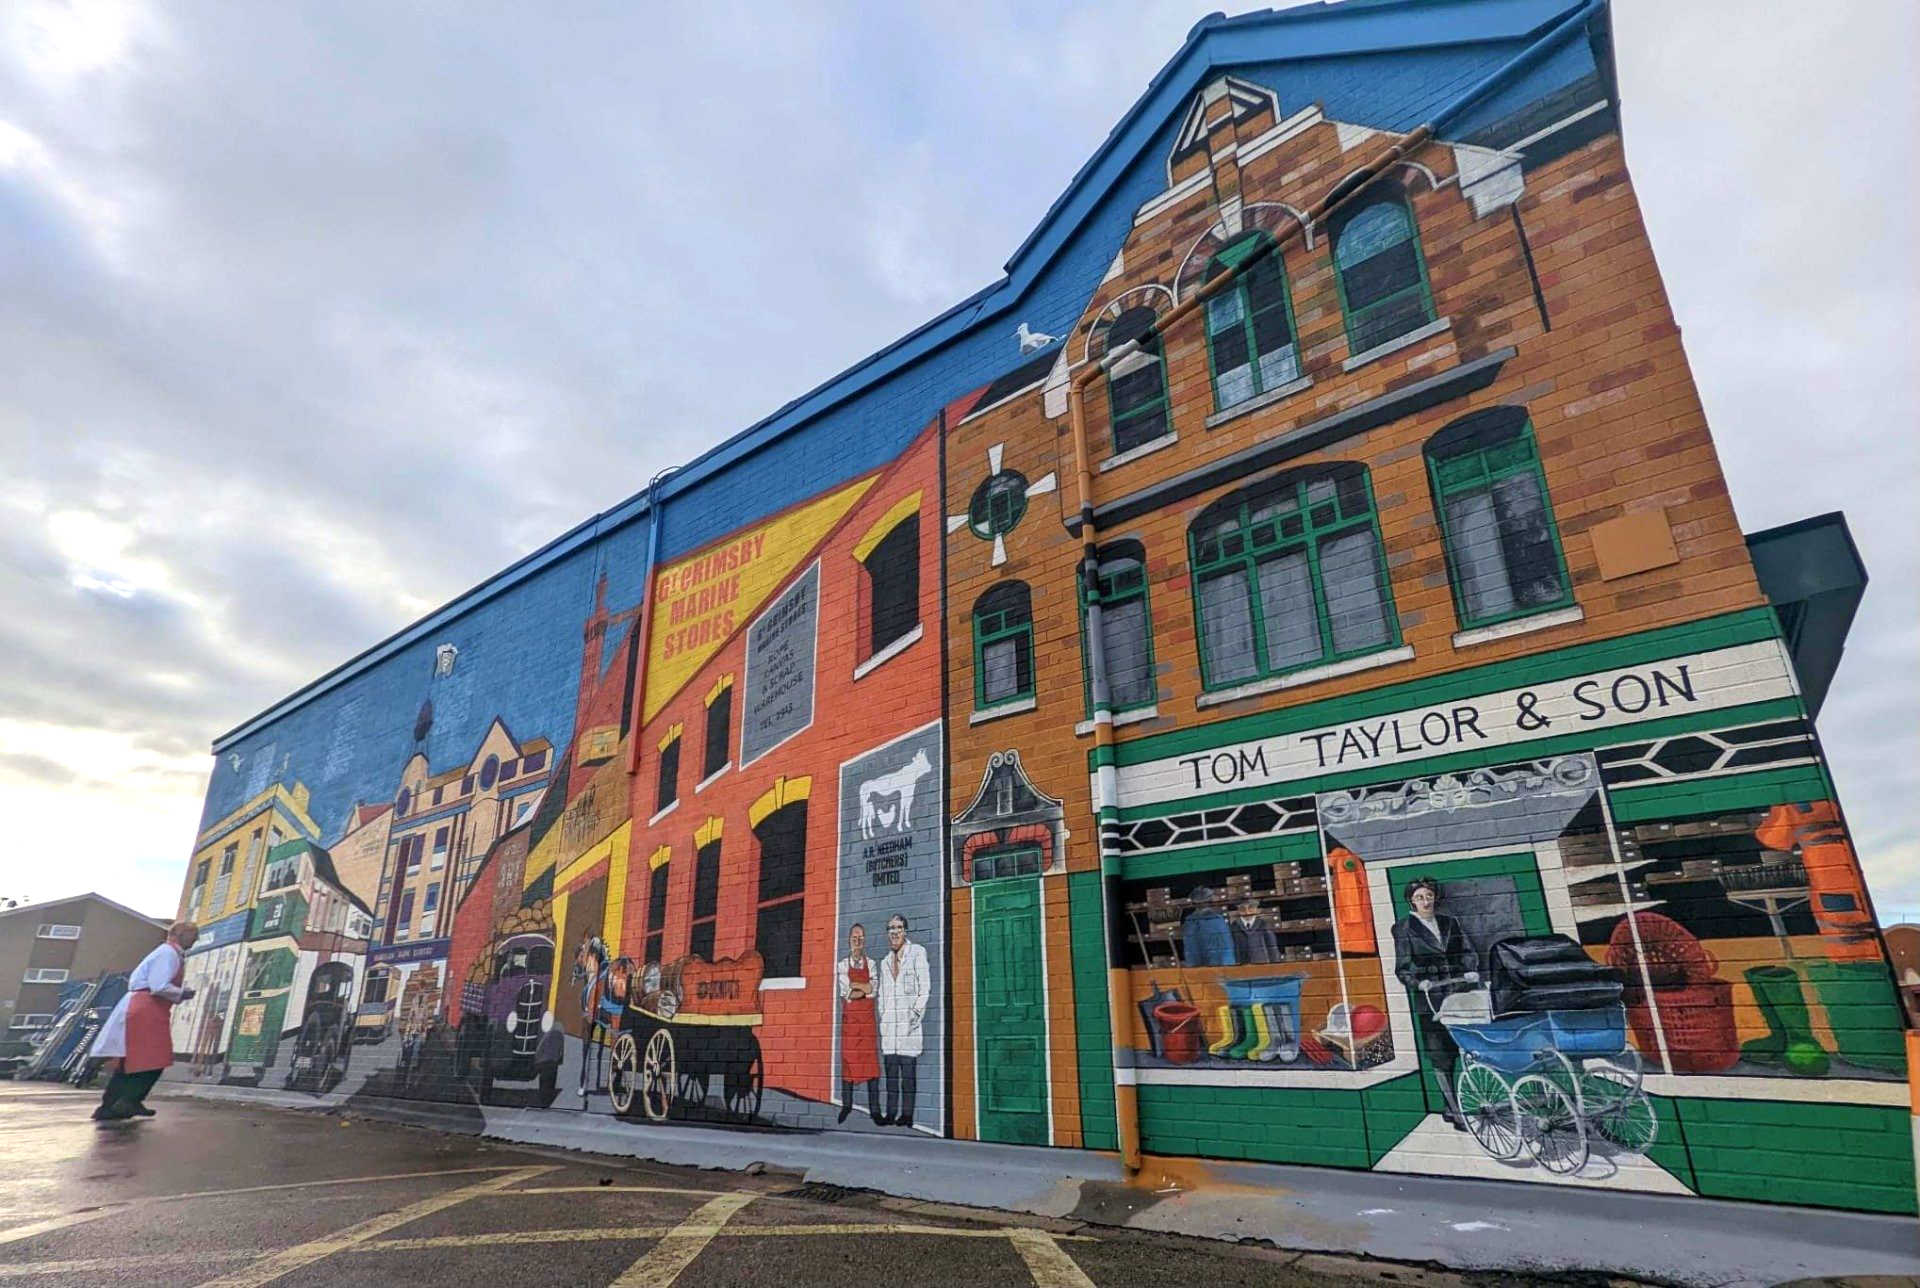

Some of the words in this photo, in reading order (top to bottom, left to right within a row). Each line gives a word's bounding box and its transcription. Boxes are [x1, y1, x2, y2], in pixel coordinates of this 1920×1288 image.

[681, 532, 767, 591] GRIMSBY
[670, 573, 740, 626] MARINE
[663, 608, 735, 660] STORES
[753, 670, 804, 715] WAREHOUSE
[769, 661, 795, 690] SCRAP
[1179, 745, 1269, 789] TOM
[1300, 705, 1488, 767] TAYLOR
[1516, 691, 1551, 731] &
[1573, 664, 1698, 720] SON
[877, 836, 913, 856] NEEDHAM
[872, 870, 900, 887] LIMITED
